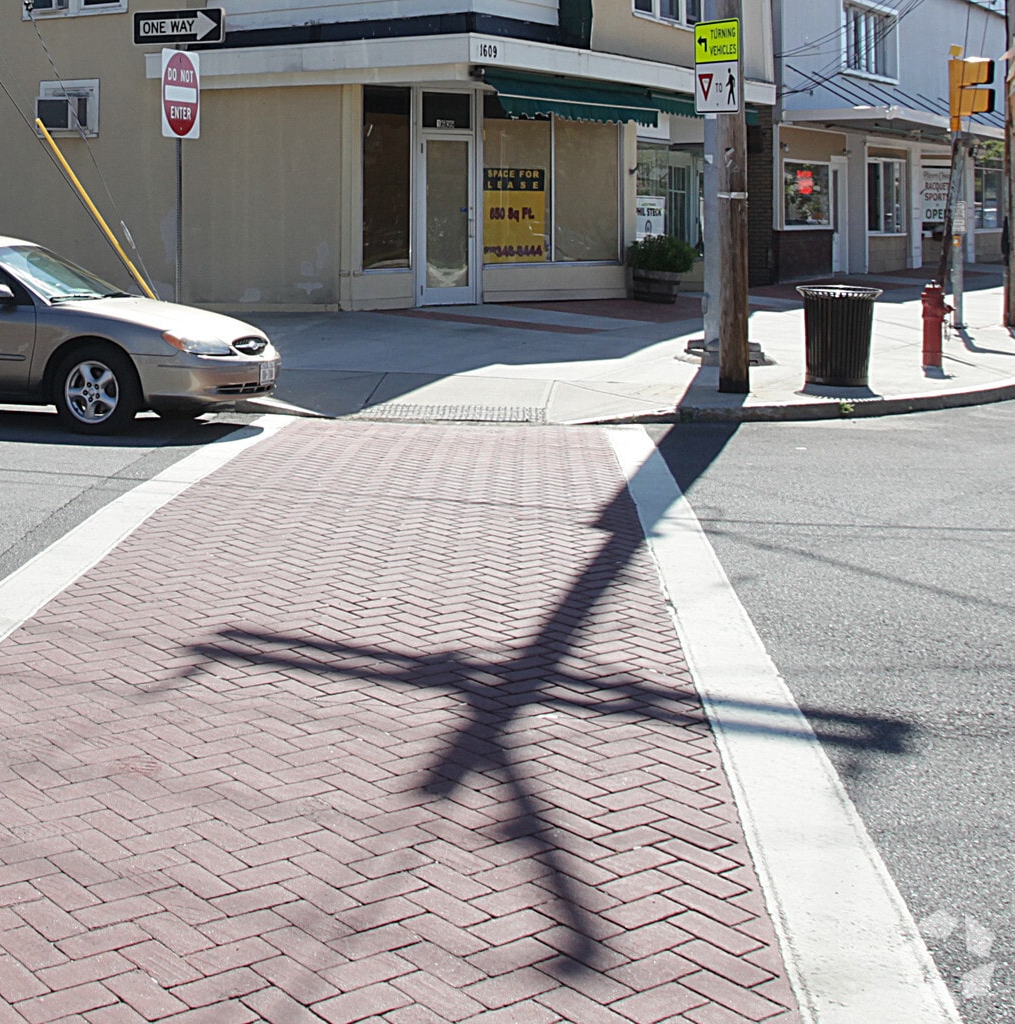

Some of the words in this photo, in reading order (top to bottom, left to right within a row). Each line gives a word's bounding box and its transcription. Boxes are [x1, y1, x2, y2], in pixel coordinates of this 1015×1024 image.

[143, 21, 166, 34] ONE
[170, 20, 195, 33] WAY
[710, 27, 736, 39] TURNING
[480, 44, 497, 58] 1609
[709, 44, 736, 56] VEHICLES
[167, 67, 177, 81] DO
[180, 69, 193, 82] NOT
[715, 82, 722, 93] TO
[170, 106, 192, 120] ENTER
[487, 169, 516, 178] SPACE
[519, 170, 539, 178] FOR
[487, 181, 539, 189] LEASE
